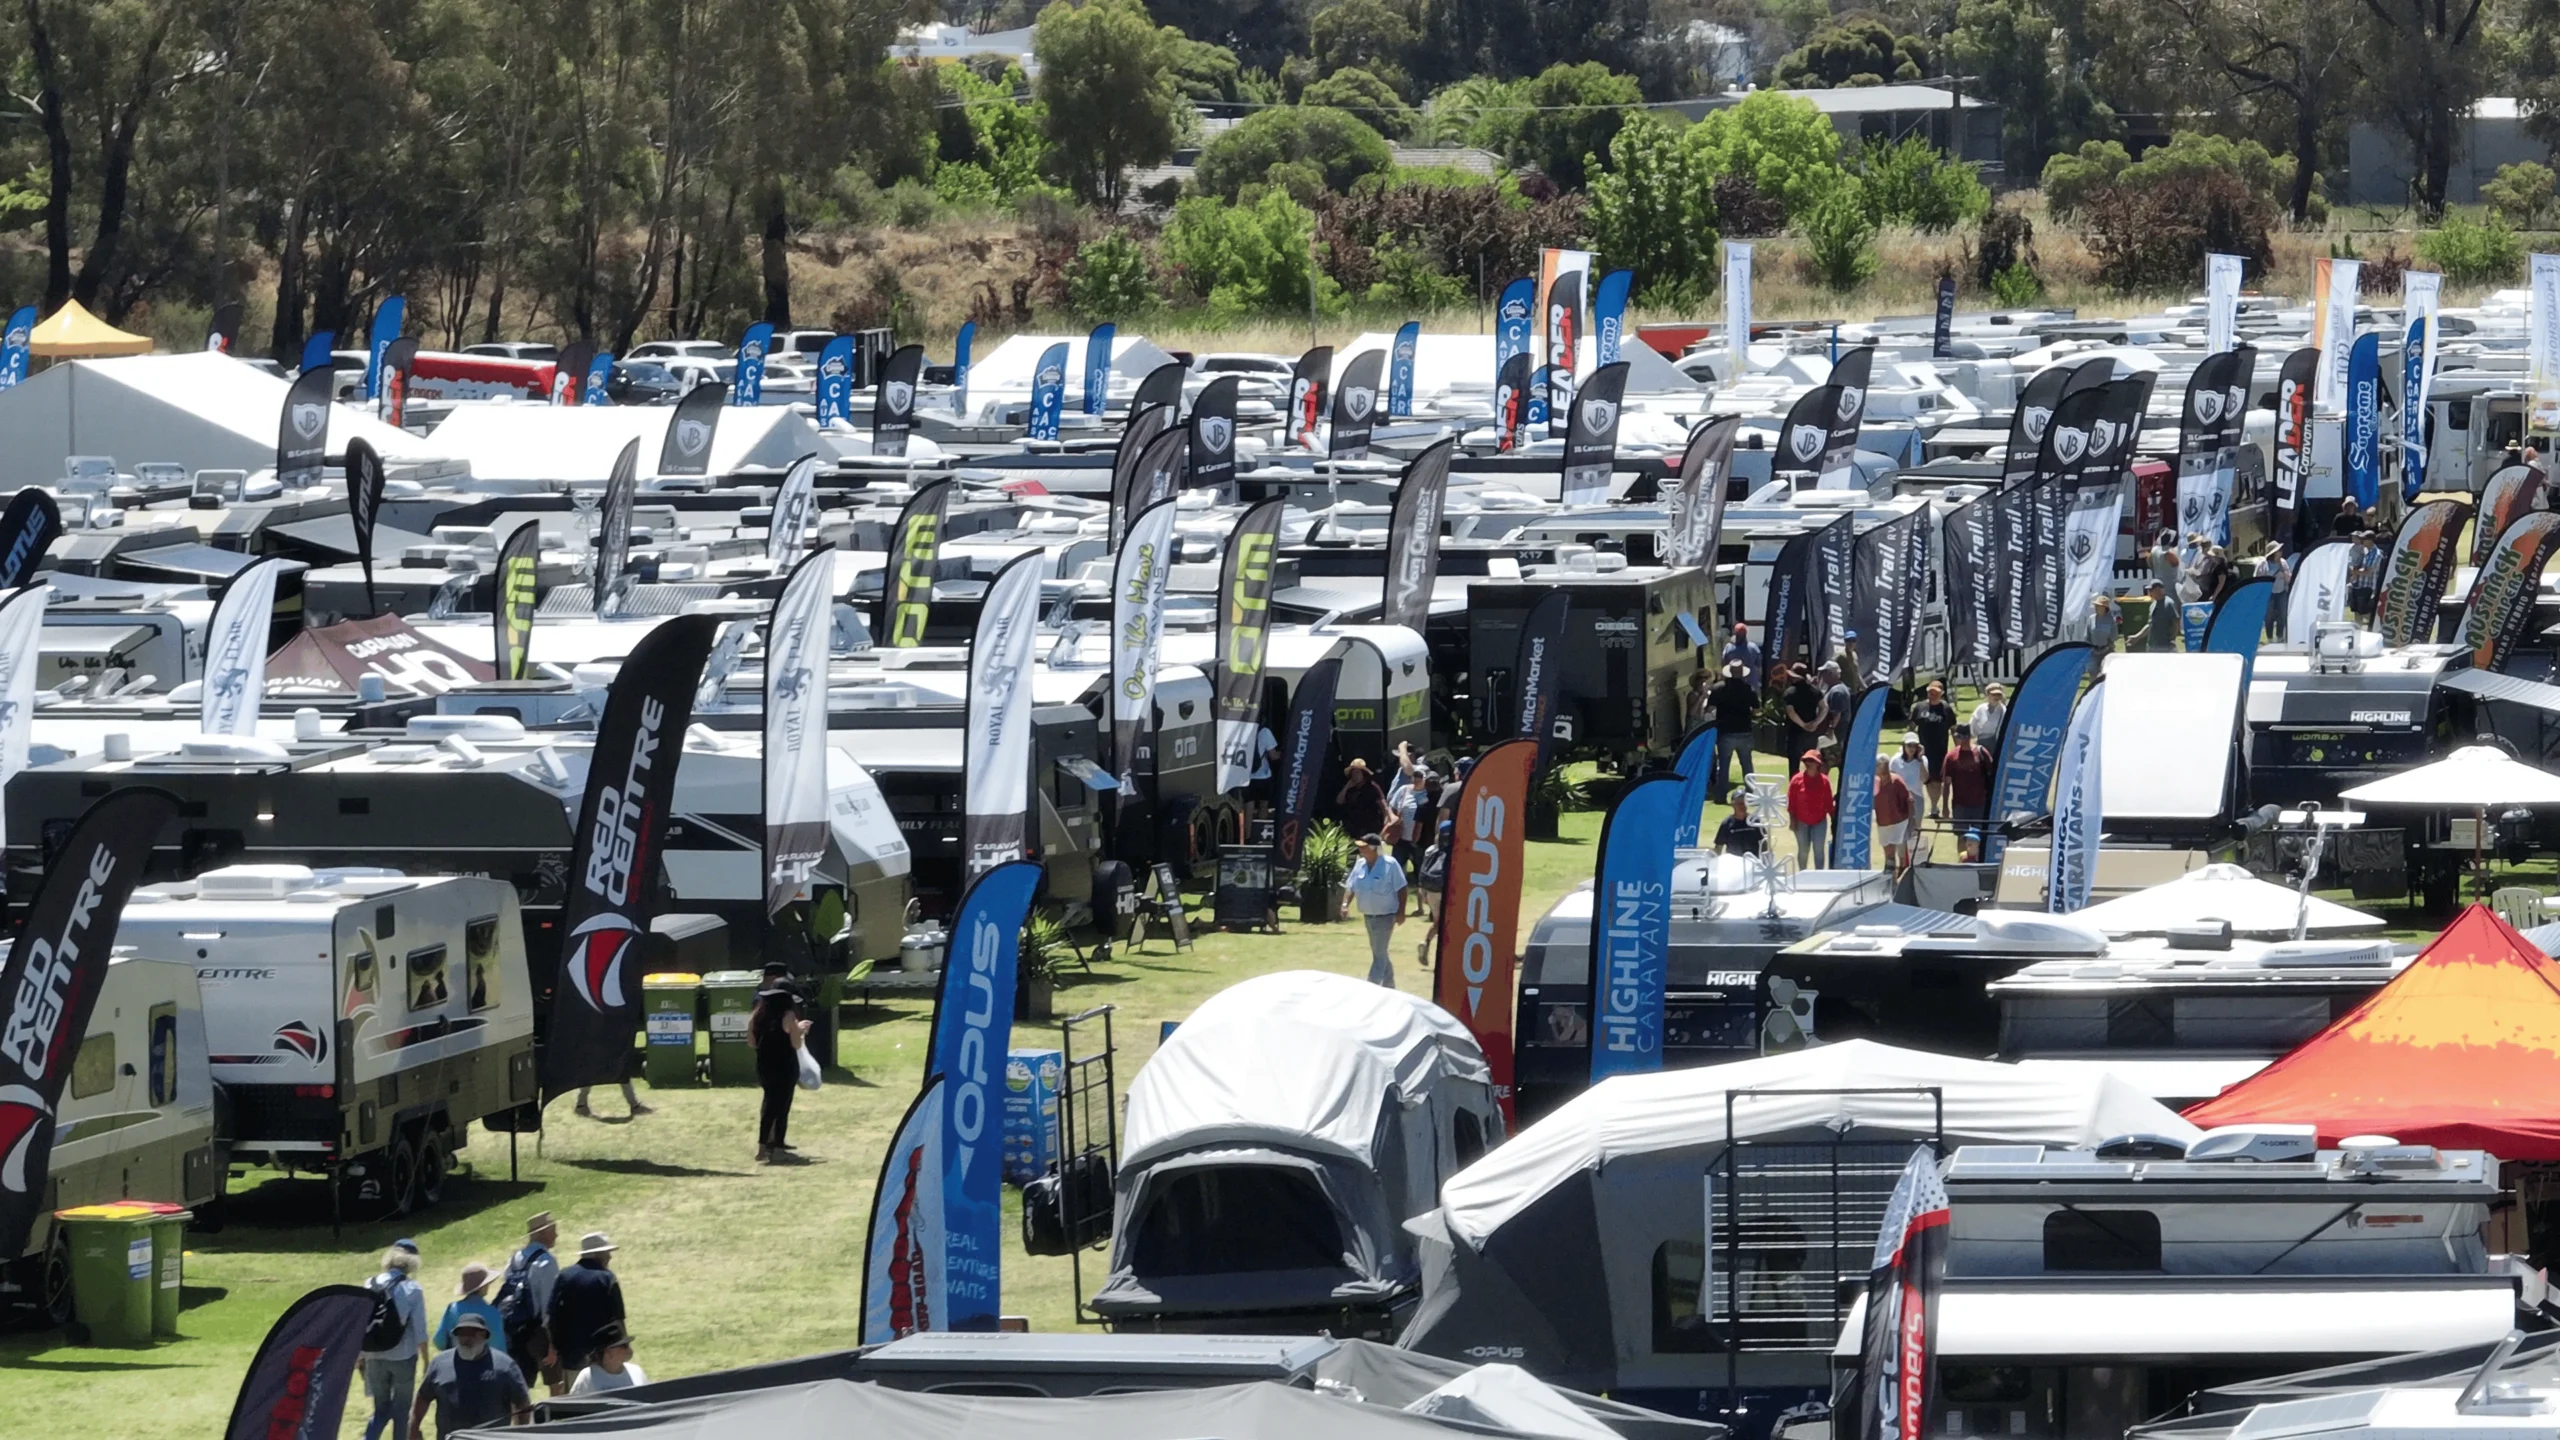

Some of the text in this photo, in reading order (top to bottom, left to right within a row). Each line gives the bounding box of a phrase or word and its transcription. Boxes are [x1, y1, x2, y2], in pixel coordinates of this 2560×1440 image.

[2546, 281, 2559, 379] MOTORHOMES
[1550, 304, 1573, 428] LEADER
[300, 411, 318, 432] JB
[893, 388, 907, 408] JB
[1354, 392, 1368, 415] JB
[1590, 406, 1609, 429] JB
[2201, 396, 2217, 418] JB
[2350, 380, 2371, 473] Supreme
[686, 427, 701, 446] JB
[1209, 425, 1225, 447] JB
[1585, 443, 1613, 453] Caravans
[1797, 432, 1818, 454] JB
[2061, 434, 2080, 459] JB
[2277, 378, 2305, 510] LEADER
[2299, 417, 2312, 476] Caravans
[357, 450, 374, 535] LOTUS
[0, 504, 47, 588] LOTUS
[1829, 527, 1839, 542] RV
[1986, 504, 1995, 546] EXPLORE
[2069, 532, 2091, 561] JB
[1519, 551, 1544, 560] X17
[1822, 546, 1842, 596] Trail
[1875, 543, 1896, 591] Trail
[1887, 524, 1897, 541] RV
[1896, 529, 1909, 627] LIVE LOVE EXPLORE
[1910, 535, 1923, 579] Trail
[1966, 502, 1991, 660] Mountain Trail RV
[1988, 551, 1996, 574] LOVE
[2005, 491, 2024, 647] Mountain Trail RV
[2036, 486, 2058, 638] Mountain Trail RV
[2428, 537, 2448, 589] CARAVANS
[1123, 543, 1154, 700] On The Move
[1147, 567, 1163, 675] CARAVANS
[1771, 574, 1792, 661] MitchMarket
[2318, 583, 2331, 611] RV
[2382, 548, 2421, 645] USTRACK
[2401, 571, 2427, 643] CAMPERS
[2417, 596, 2431, 632] HYBRID
[2464, 545, 2523, 650] AUSTRACK
[2488, 571, 2525, 640] CAMPERS
[225, 619, 242, 660] FLAIR
[346, 632, 420, 659] CARAVAN
[2491, 635, 2510, 671] FFROAD
[2507, 596, 2528, 630] HYBRID
[263, 677, 341, 689] ARAVAN
[367, 650, 480, 697] HQ
[1521, 637, 1546, 733] MitchMarket
[786, 707, 801, 753] ROYAL
[988, 704, 1004, 746] ROYAL
[2350, 710, 2412, 723] HIGHLINE
[1285, 709, 1313, 814] MitchMarket
[2002, 722, 2042, 809] HLINE
[2027, 726, 2061, 808] AVANS
[607, 696, 664, 906] CENTRE
[1842, 773, 1861, 868] HLINE
[1855, 773, 1870, 868] AVANS
[585, 786, 621, 895] RED
[1463, 794, 1505, 983] OPUS
[2004, 866, 2048, 877] HIGHL
[23, 843, 117, 1080] CENTRE
[1607, 880, 1642, 1051] HIGHLINE
[1638, 883, 1663, 1052] CARAVANS
[1707, 971, 1761, 985] HIGHL
[1, 937, 52, 1063] RED
[954, 920, 1001, 1143] OPUS
[945, 1231, 979, 1251] REAL
[947, 1256, 998, 1280] ENTURE
[947, 1279, 988, 1300] WAITS
[1472, 1346, 1524, 1358] OPUS
